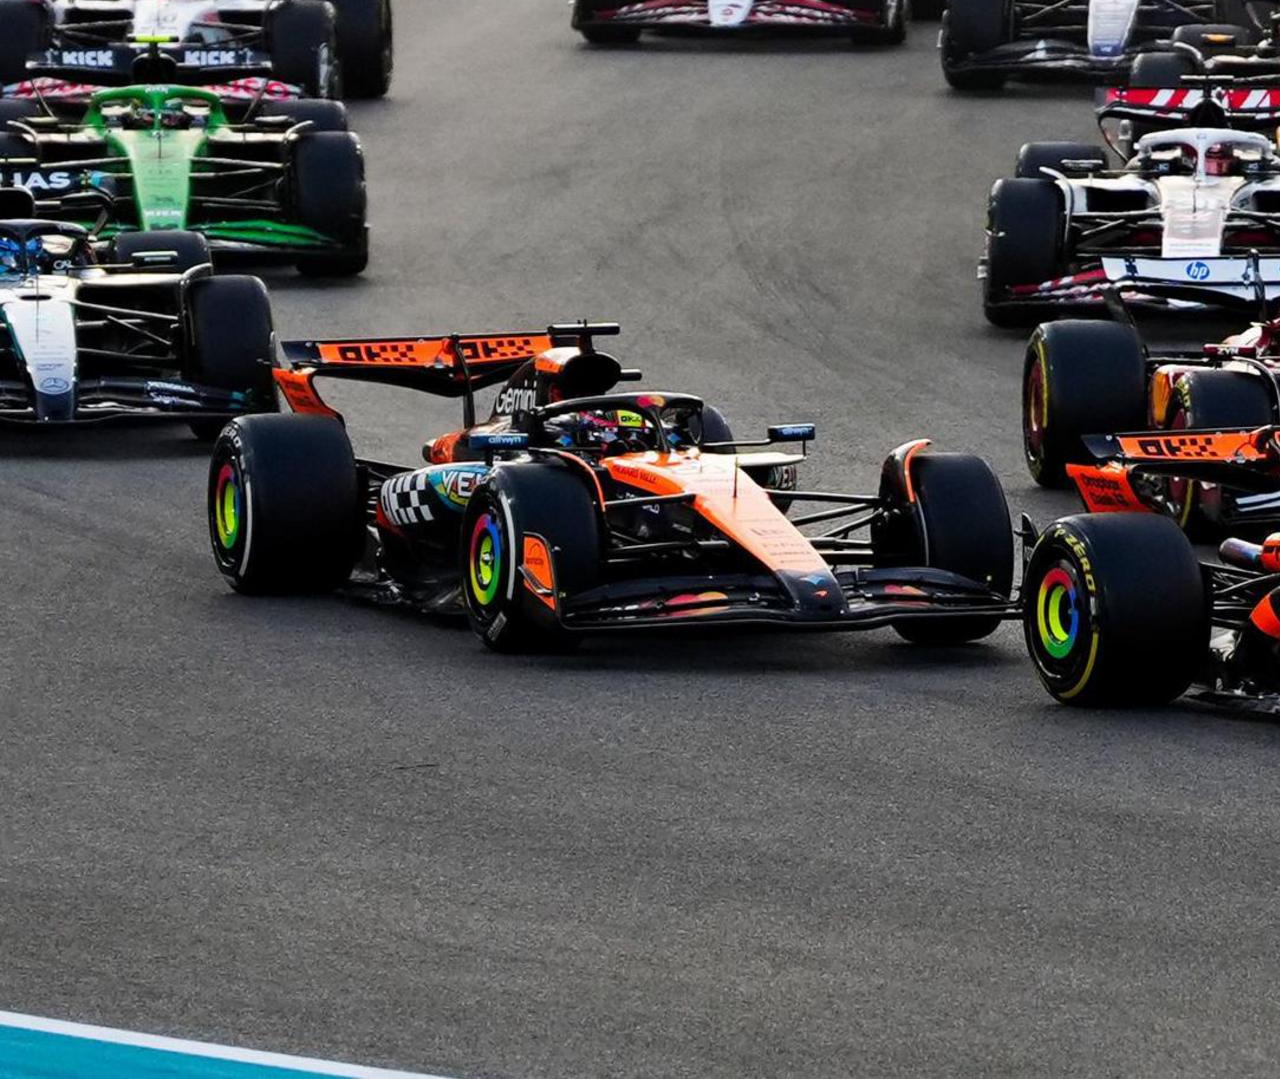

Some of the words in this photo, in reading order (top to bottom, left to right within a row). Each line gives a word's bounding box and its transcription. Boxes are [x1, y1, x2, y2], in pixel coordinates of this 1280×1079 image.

[62, 50, 113, 66] KICK
[185, 50, 235, 66] KICK
[1189, 262, 1208, 280] hp
[1217, 346, 1239, 356] ZYN
[495, 379, 538, 414] Gemini
[488, 433, 522, 446] allwyn
[1067, 531, 1096, 595] ZERO
